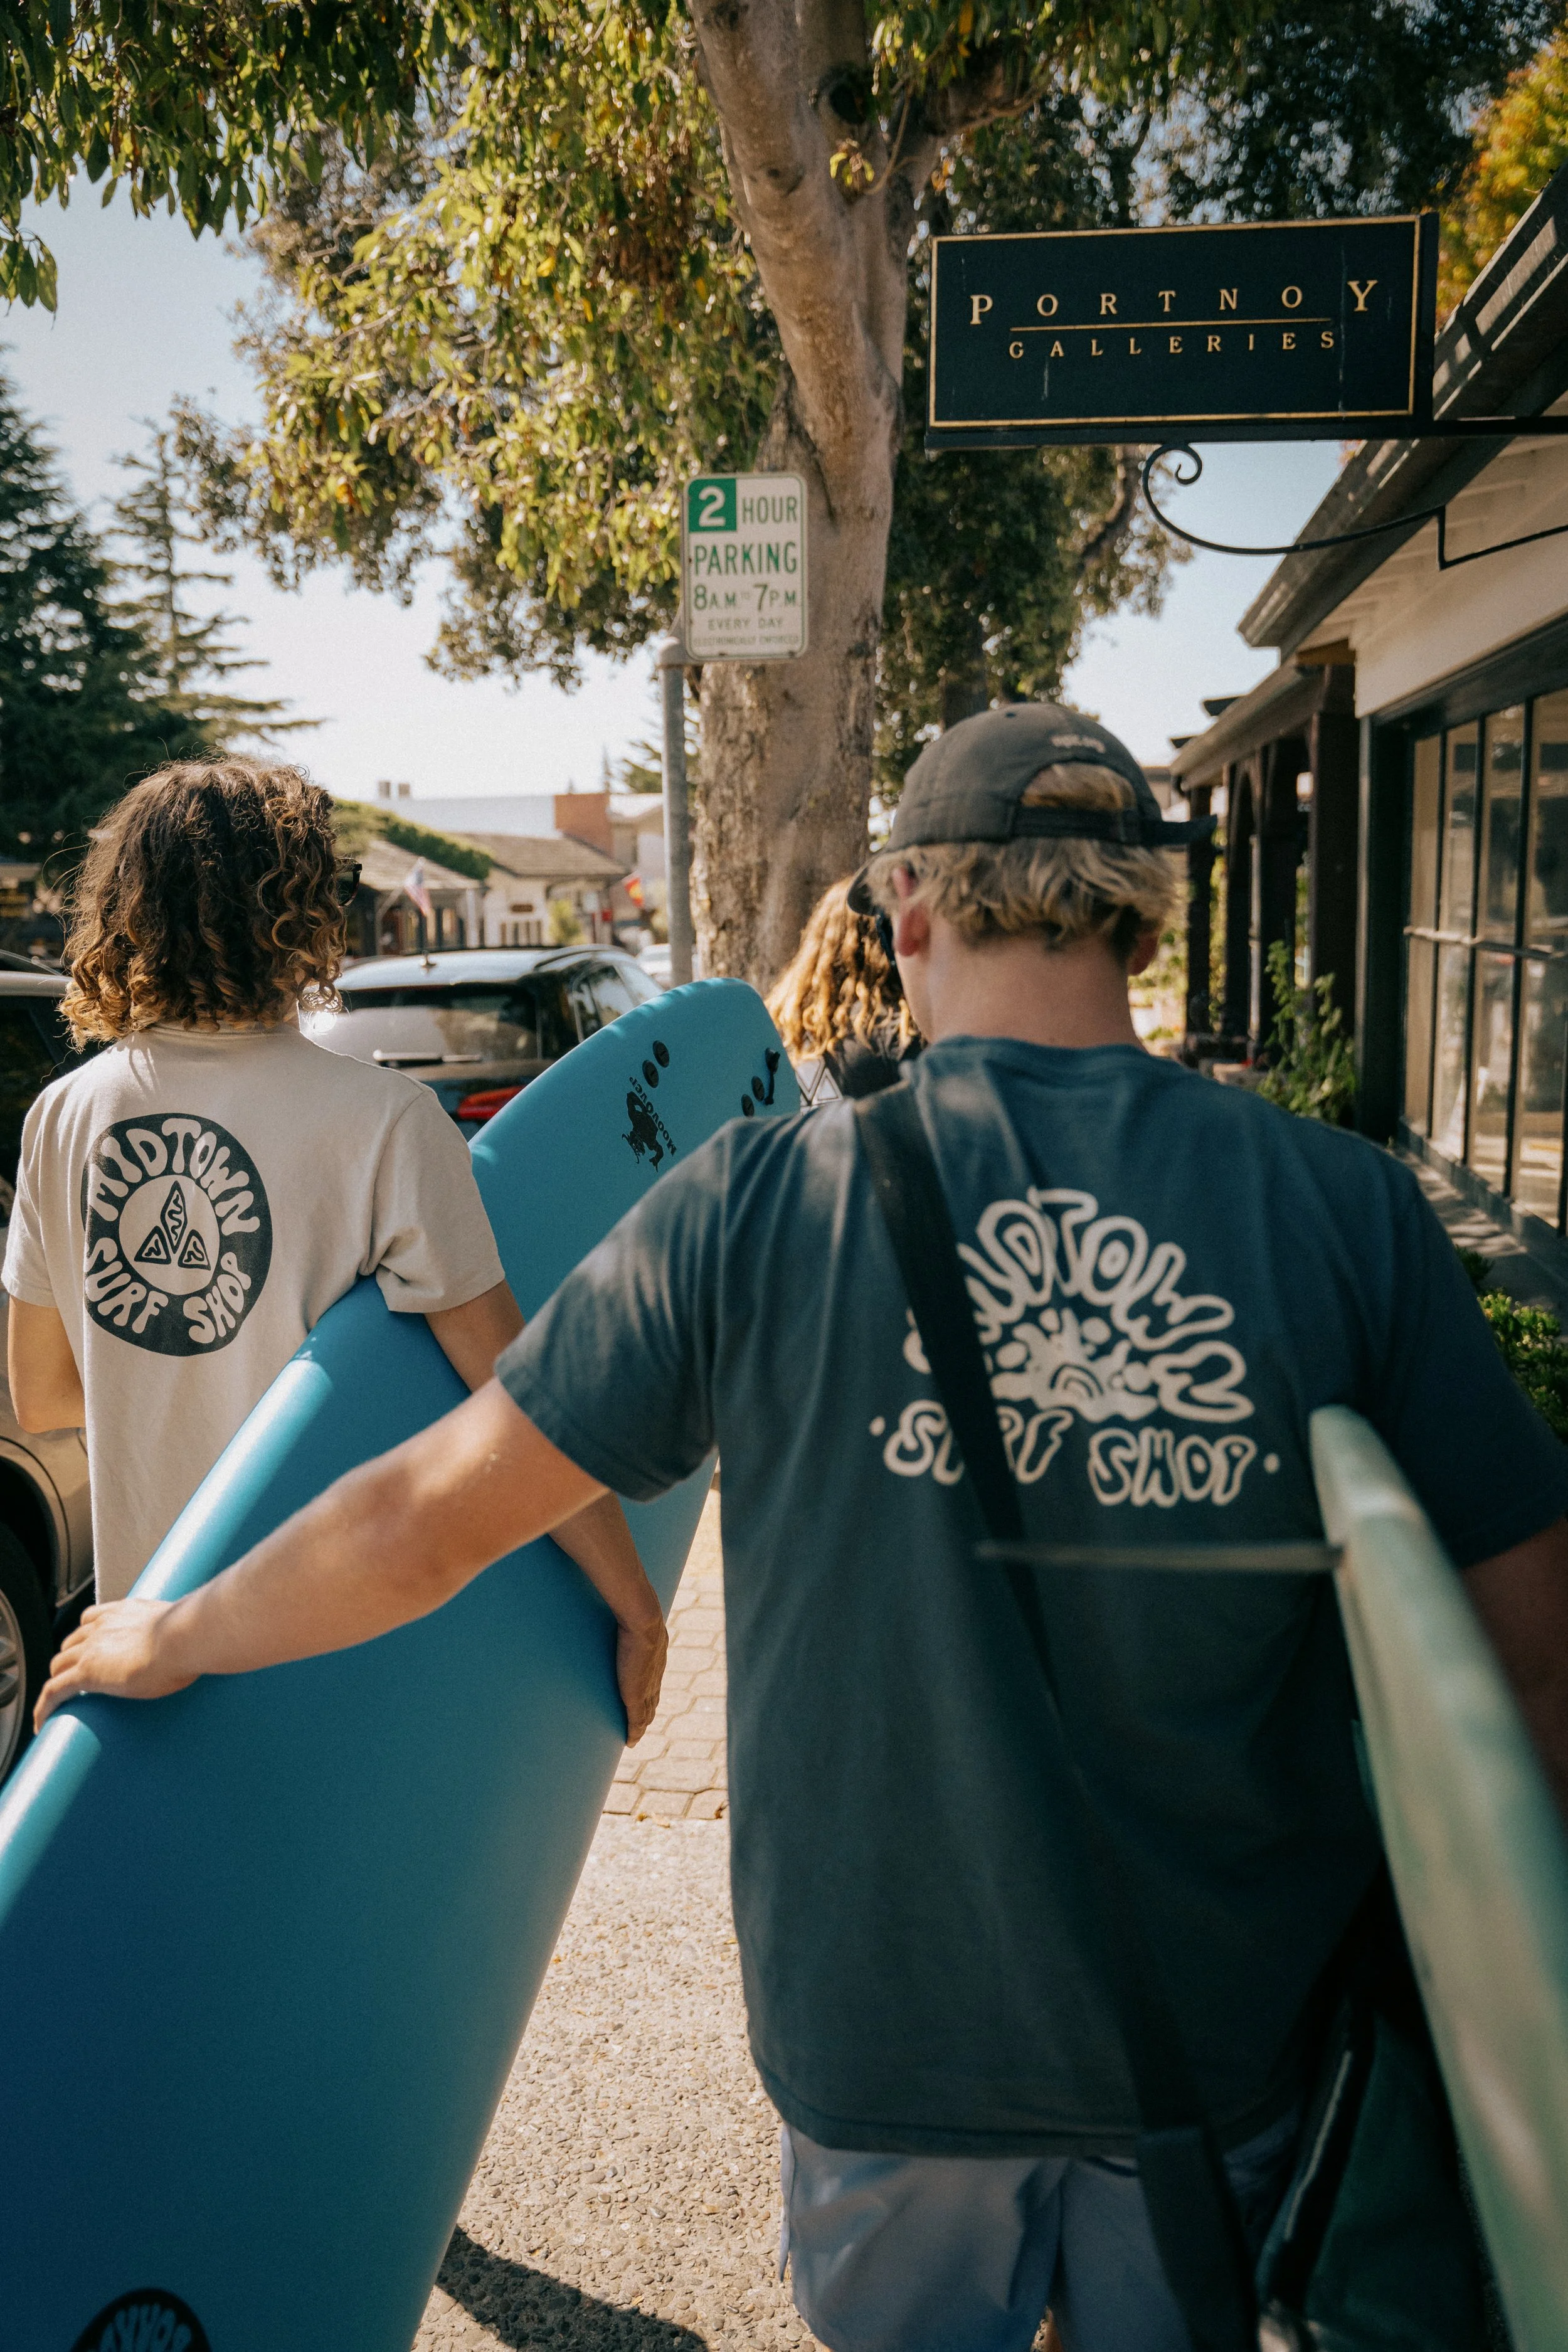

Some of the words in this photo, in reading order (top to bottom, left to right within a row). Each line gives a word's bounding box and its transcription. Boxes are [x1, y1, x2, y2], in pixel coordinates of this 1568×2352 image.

[969, 280, 1378, 325] PORTNOY
[1009, 331, 1335, 359] GALLERIES
[698, 486, 726, 527] 2
[742, 496, 798, 524] HOUR
[694, 541, 797, 576] PARKING
[707, 617, 751, 631] EVERY
[758, 617, 783, 630] DAY
[87, 1118, 260, 1236] MIDTOWN
[83, 1237, 169, 1334] SURF
[183, 1252, 252, 1344] SHOP
[1088, 1427, 1256, 1507] SHOP
